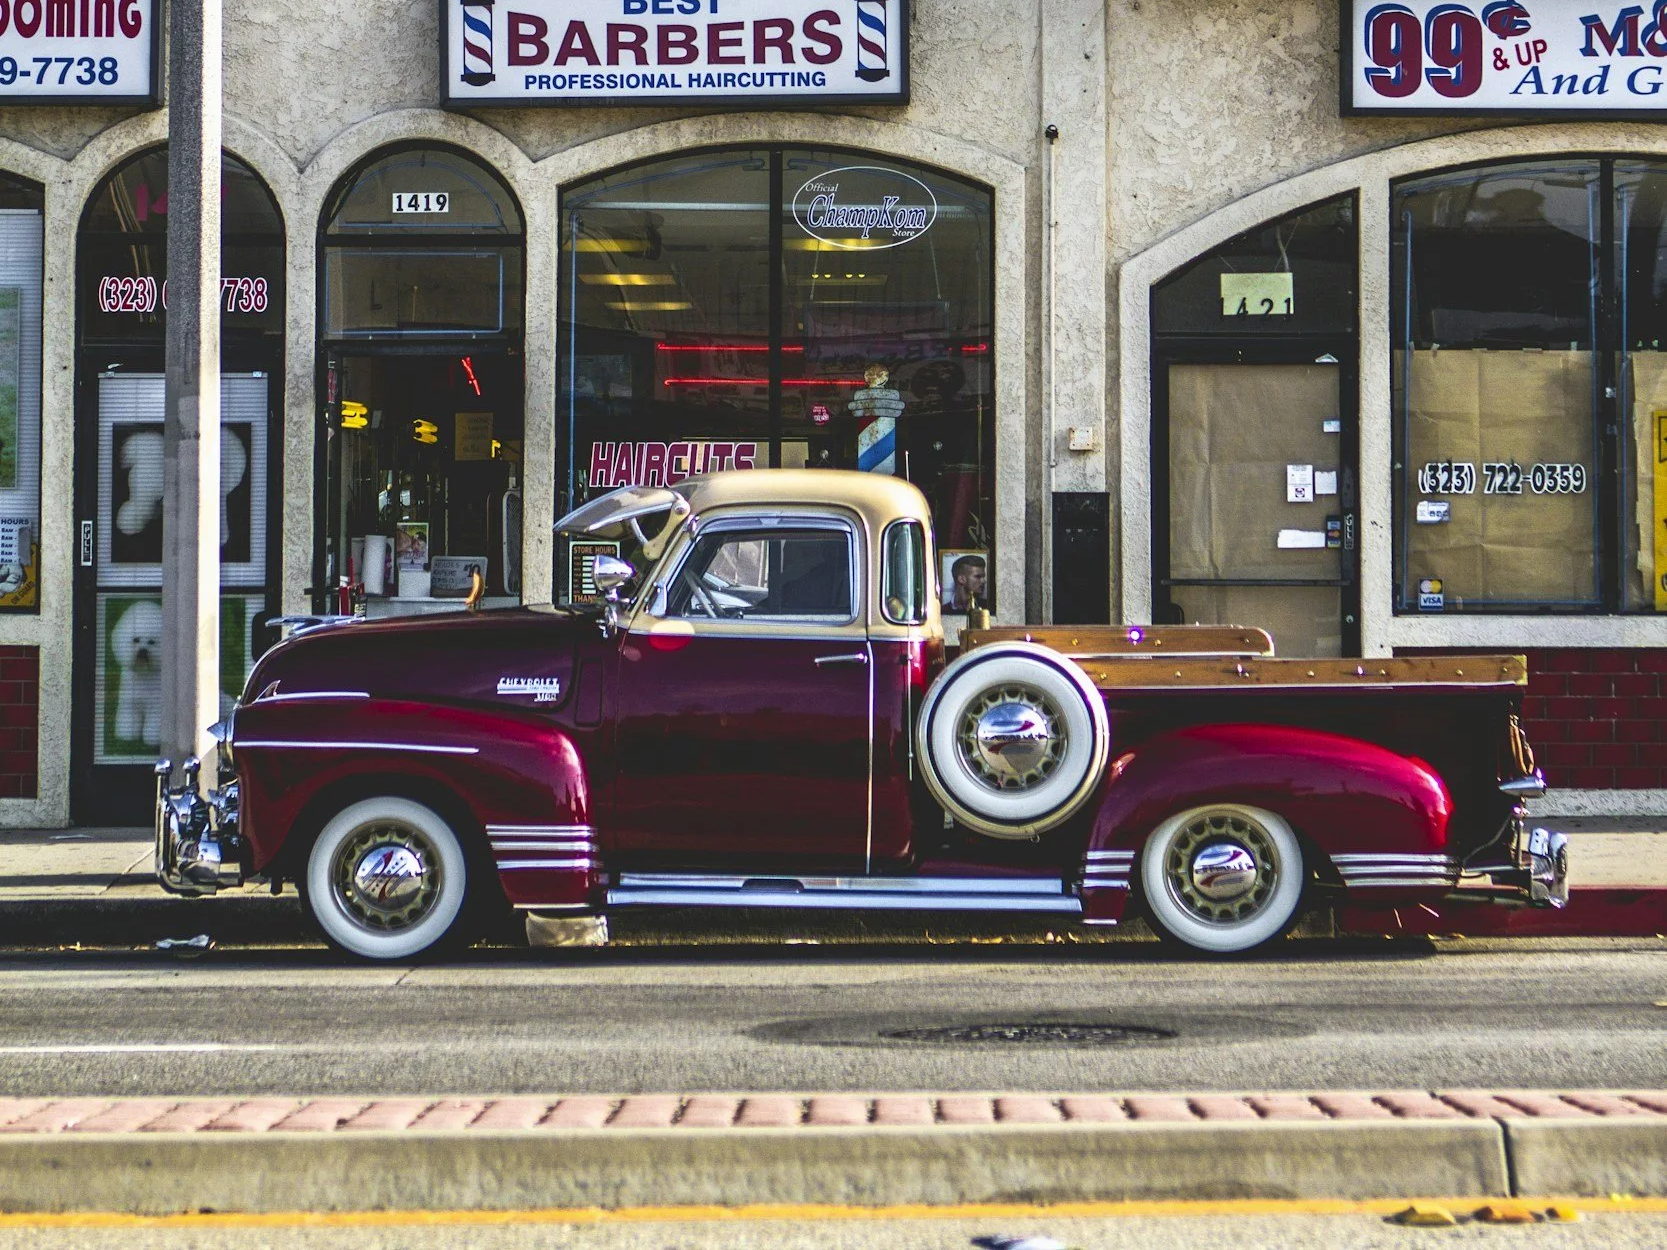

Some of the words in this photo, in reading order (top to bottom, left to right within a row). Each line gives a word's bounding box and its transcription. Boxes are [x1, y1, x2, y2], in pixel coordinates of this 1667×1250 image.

[507, 9, 843, 67] BARBERS
[1492, 47, 1510, 71] &
[1514, 38, 1548, 67] UP
[0, 56, 119, 86] 9-7738
[524, 73, 682, 90] PROFESSIONAL
[688, 71, 827, 88] HAIRCUTTING
[1509, 64, 1611, 96] And
[805, 183, 839, 192] Official
[396, 194, 448, 212] 1419
[807, 192, 927, 239] ChampKom
[892, 228, 915, 237] Store
[98, 277, 157, 312] (323)
[589, 441, 757, 488] HAIRCUTS
[1482, 462, 1587, 494] 722-0359
[573, 546, 593, 554] STORE
[595, 546, 616, 554] HOURS
[573, 595, 597, 603] THAN
[1422, 597, 1442, 605] VISA
[499, 677, 558, 686] CHEVROLET
